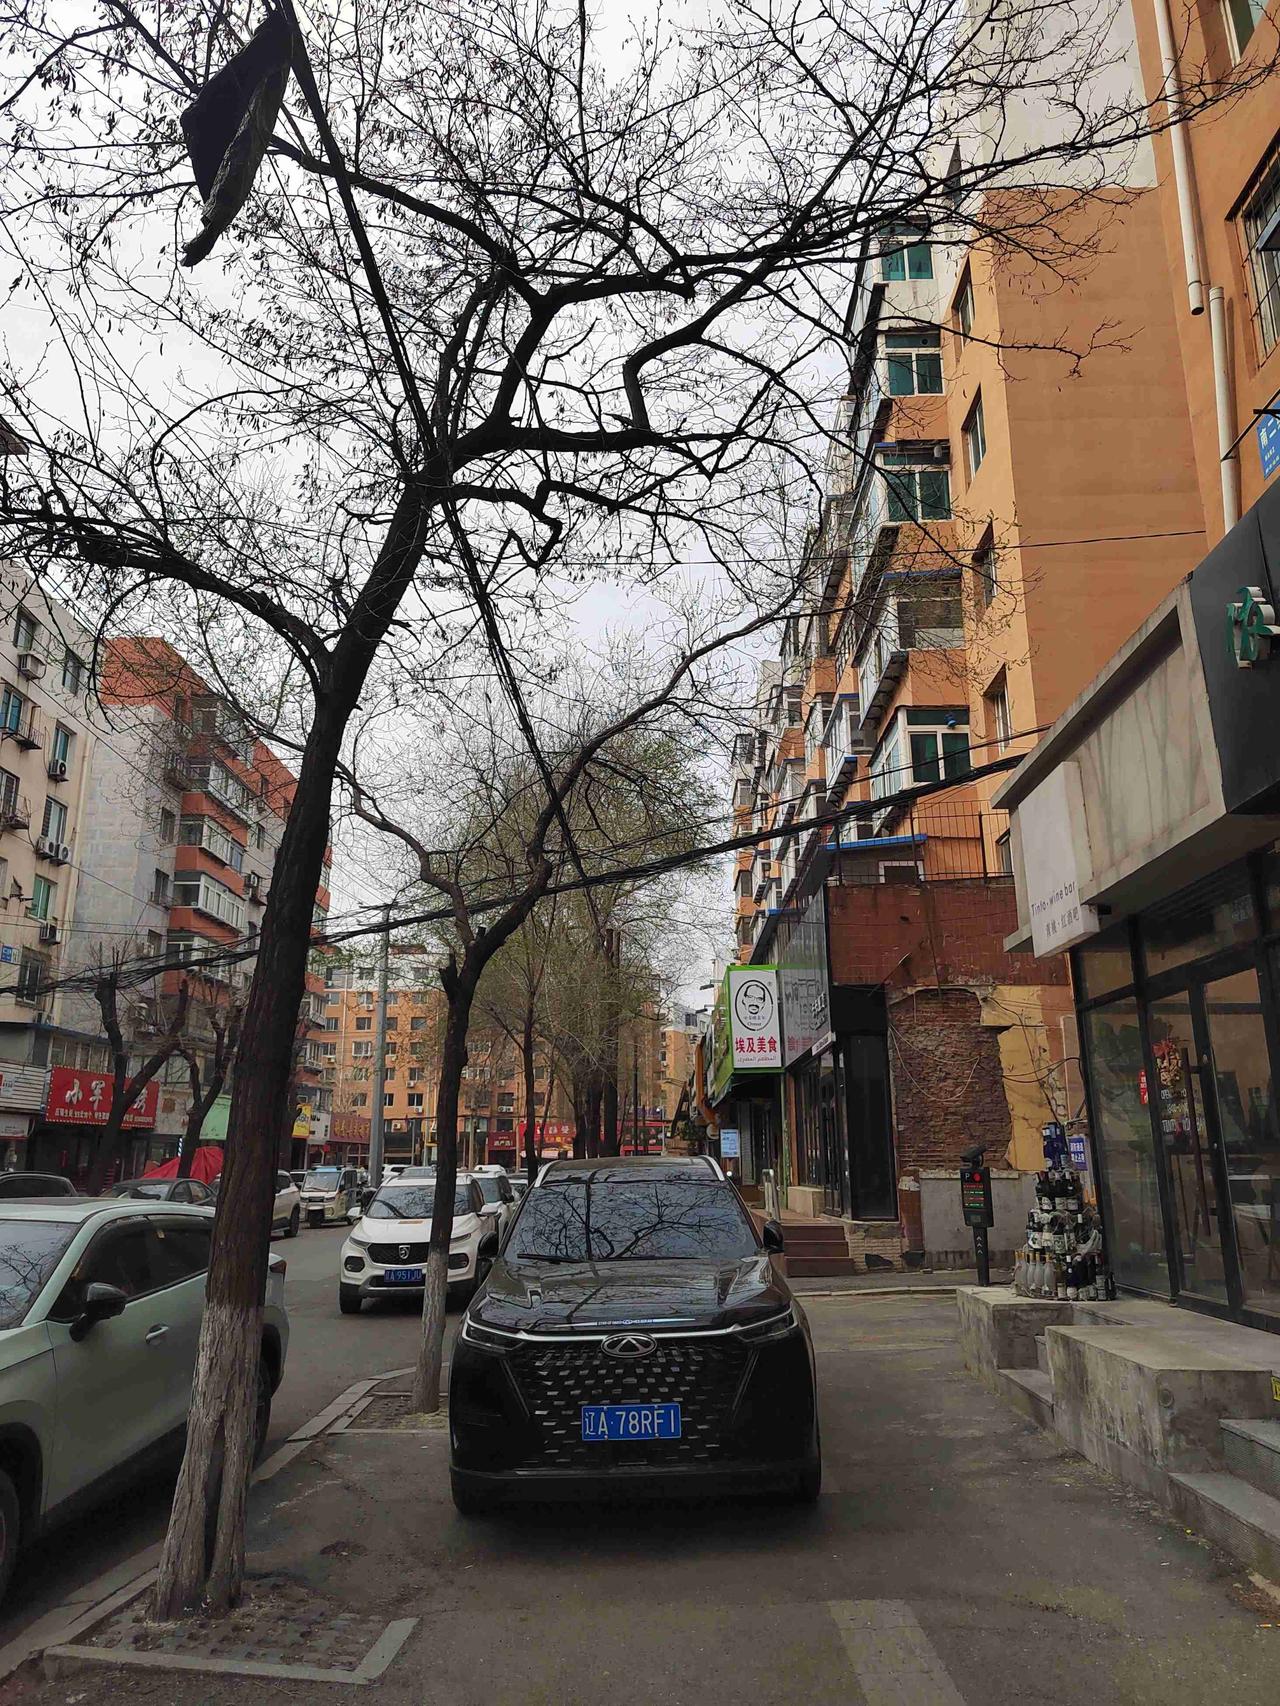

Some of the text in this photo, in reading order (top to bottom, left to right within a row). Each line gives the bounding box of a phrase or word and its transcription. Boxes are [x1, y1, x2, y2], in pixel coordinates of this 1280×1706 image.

[735, 1036, 777, 1053] 埃及美食
[965, 1172, 970, 1180] P
